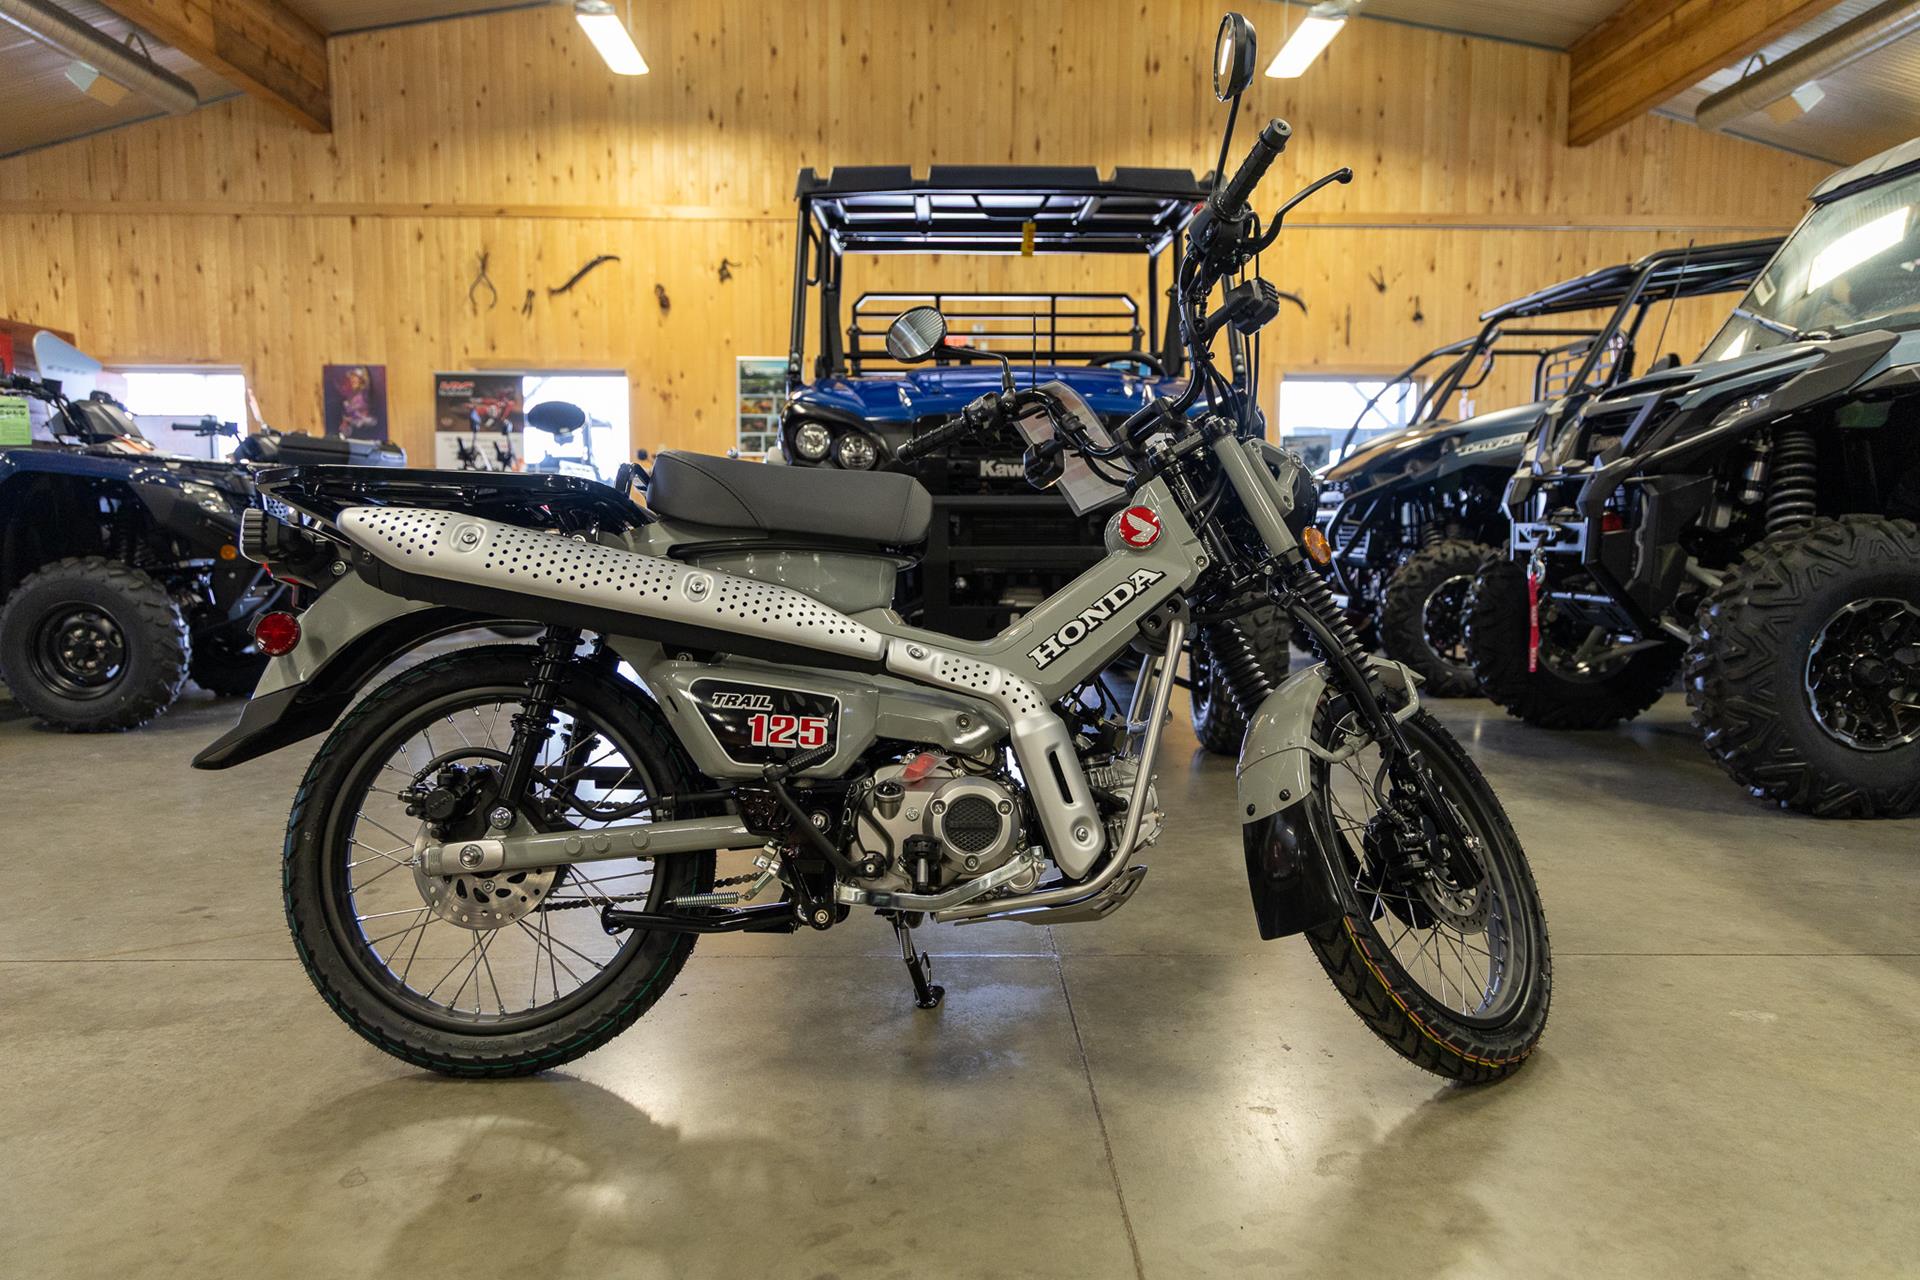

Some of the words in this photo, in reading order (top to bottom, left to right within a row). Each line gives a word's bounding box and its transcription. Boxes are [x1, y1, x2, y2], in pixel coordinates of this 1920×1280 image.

[1027, 568, 1167, 671] HONDA
[712, 692, 774, 711] TRAIL
[747, 713, 829, 750] 125
